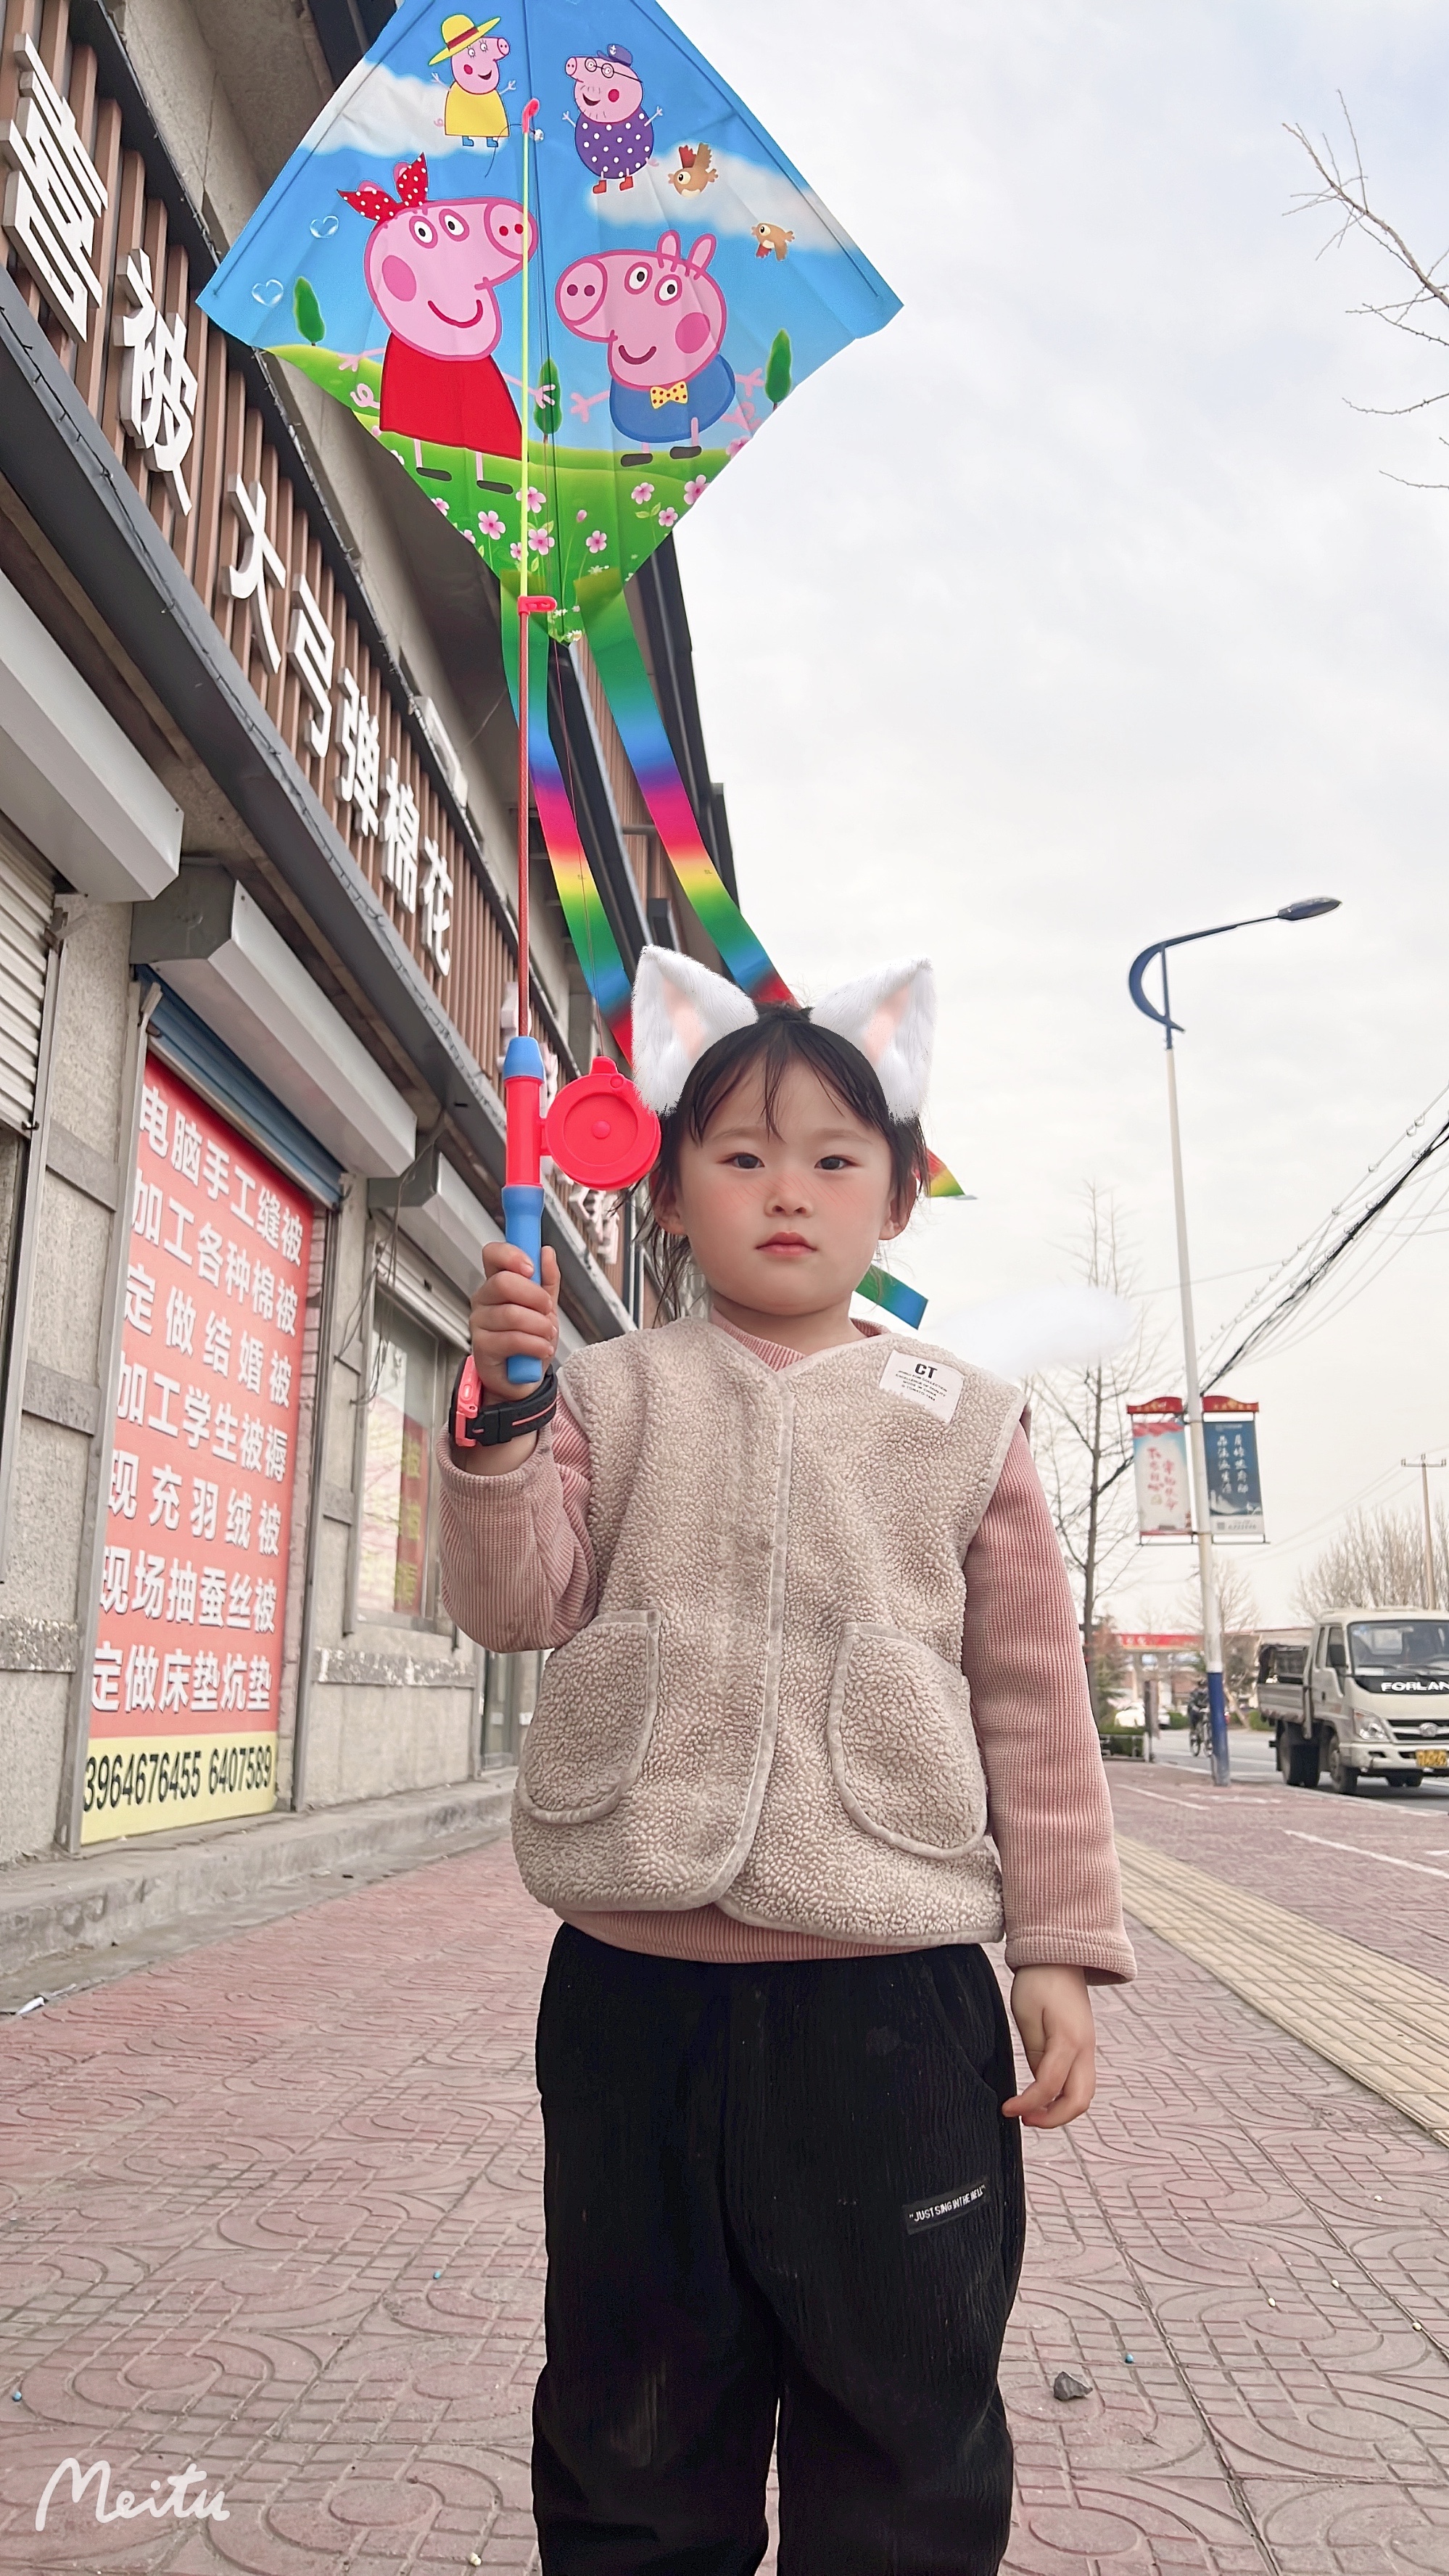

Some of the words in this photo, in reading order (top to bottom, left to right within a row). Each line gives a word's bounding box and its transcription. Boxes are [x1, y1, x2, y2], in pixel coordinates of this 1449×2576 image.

[229, 473, 453, 977] 大弓弹棉花
[140, 1084, 303, 1268] 电脑手工缝被
[132, 1168, 298, 1337] 加工各种棉被
[125, 1263, 292, 1409] 定做结婚被
[915, 1363, 938, 1379] CT
[117, 1350, 288, 1483] 加工学生被褥
[108, 1449, 281, 1556] 现充羽绒被
[99, 1545, 277, 1633] 现场抽蚕丝被
[91, 1640, 272, 1714] 定做床垫炕垫
[210, 1744, 272, 1795] 6407589
[934, 2201, 953, 2216] SING
